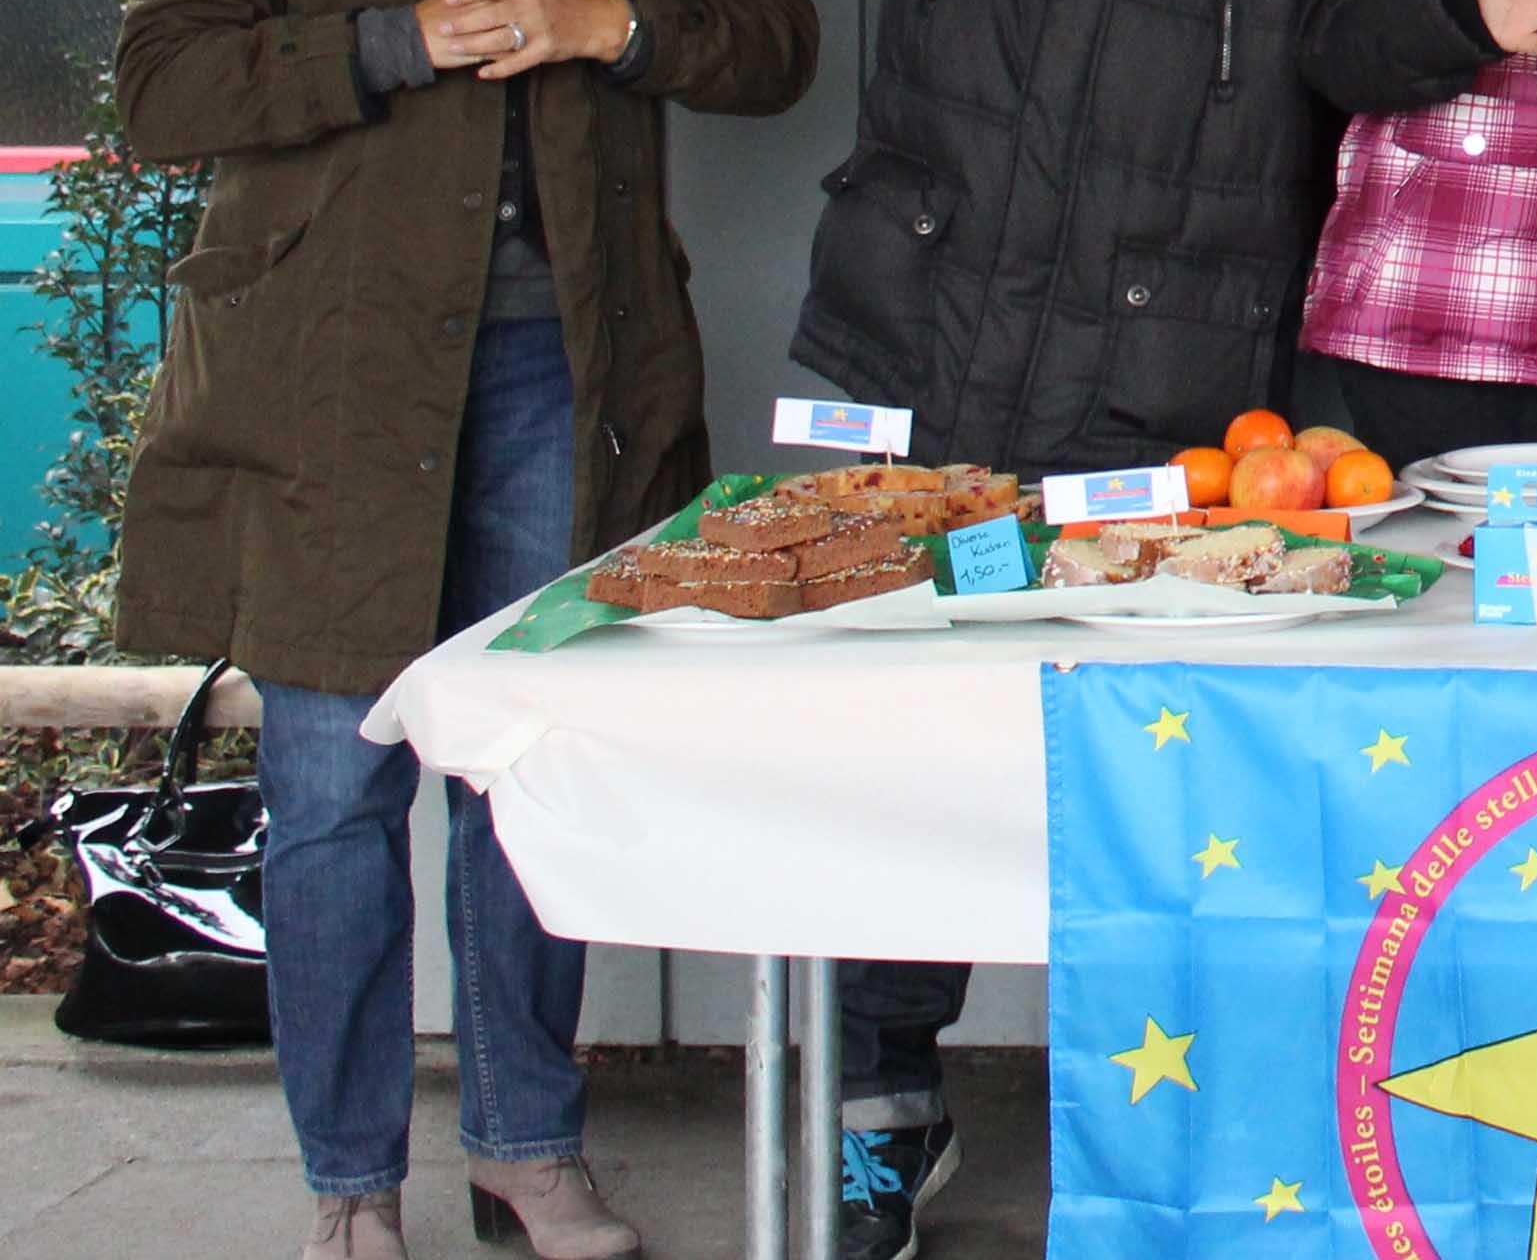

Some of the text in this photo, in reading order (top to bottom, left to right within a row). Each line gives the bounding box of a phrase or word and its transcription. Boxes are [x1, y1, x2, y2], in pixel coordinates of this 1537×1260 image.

[1411, 827, 1474, 898] delle
[1348, 902, 1419, 1065] Settimana
[1350, 1105, 1395, 1213] étoiles
